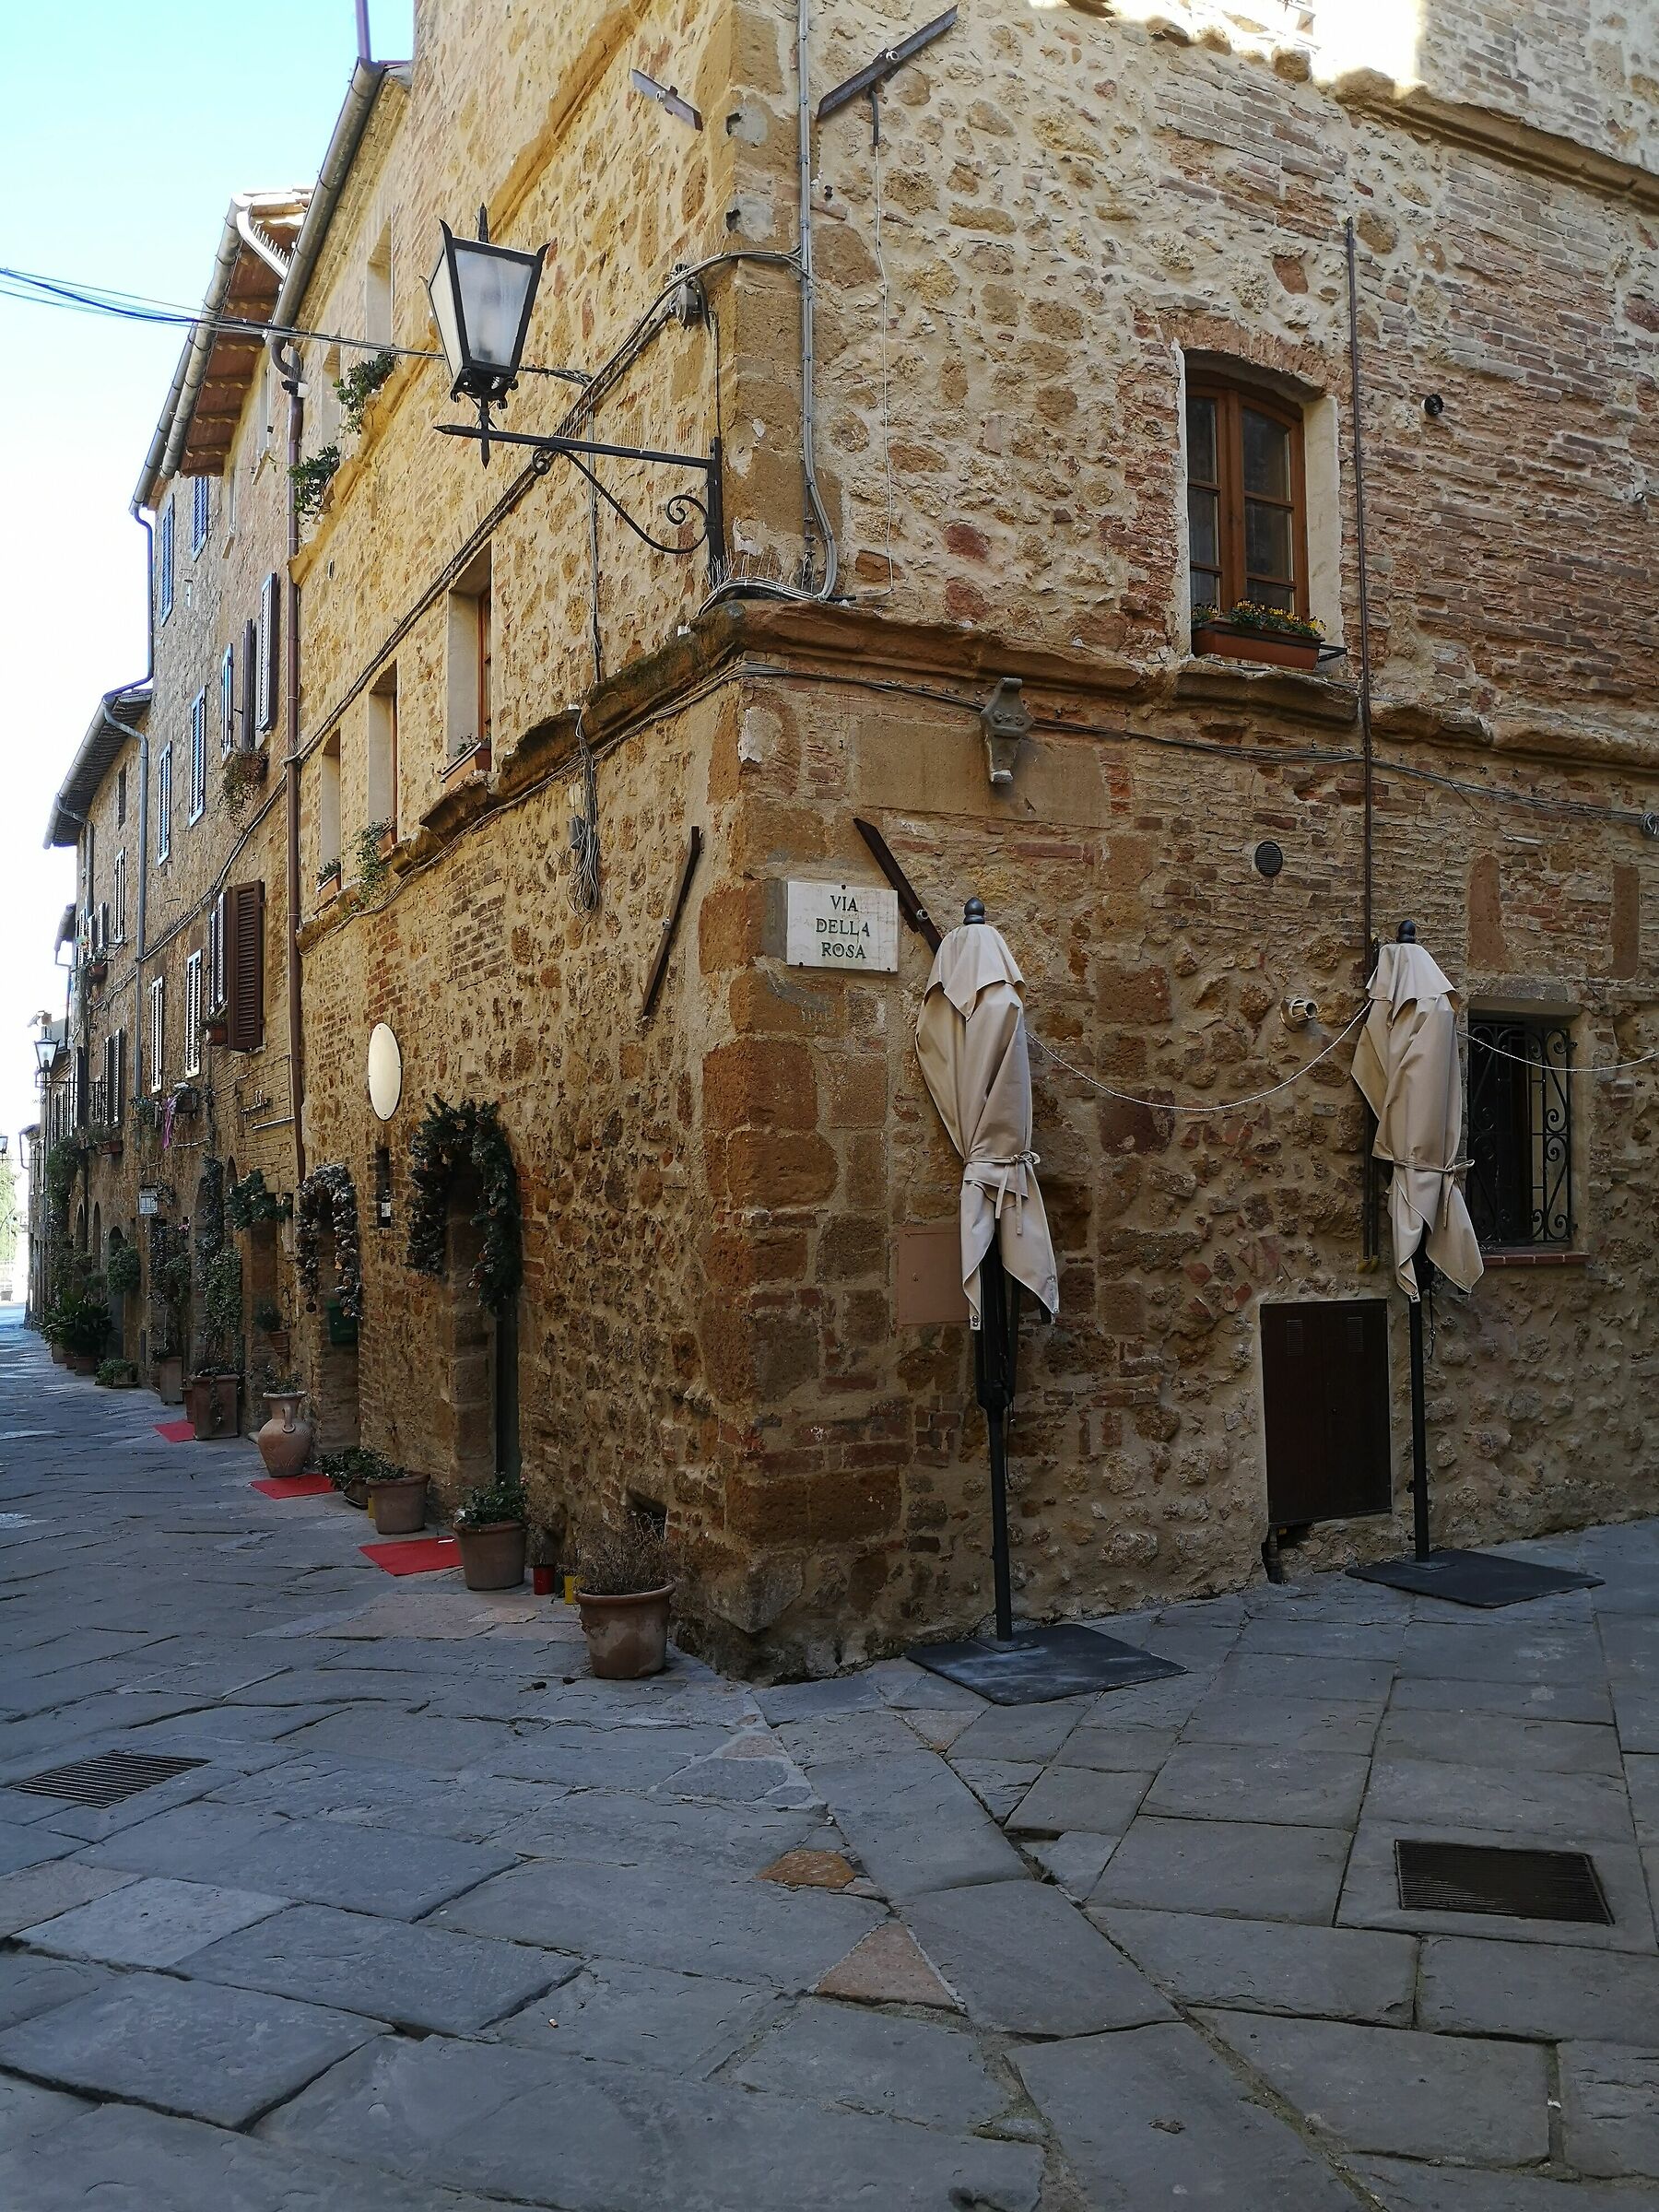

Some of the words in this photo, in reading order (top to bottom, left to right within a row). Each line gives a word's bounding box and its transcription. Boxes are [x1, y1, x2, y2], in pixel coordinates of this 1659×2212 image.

[830, 895, 858, 912] VIA
[816, 918, 870, 936] DELLA
[821, 941, 866, 959] ROSA
